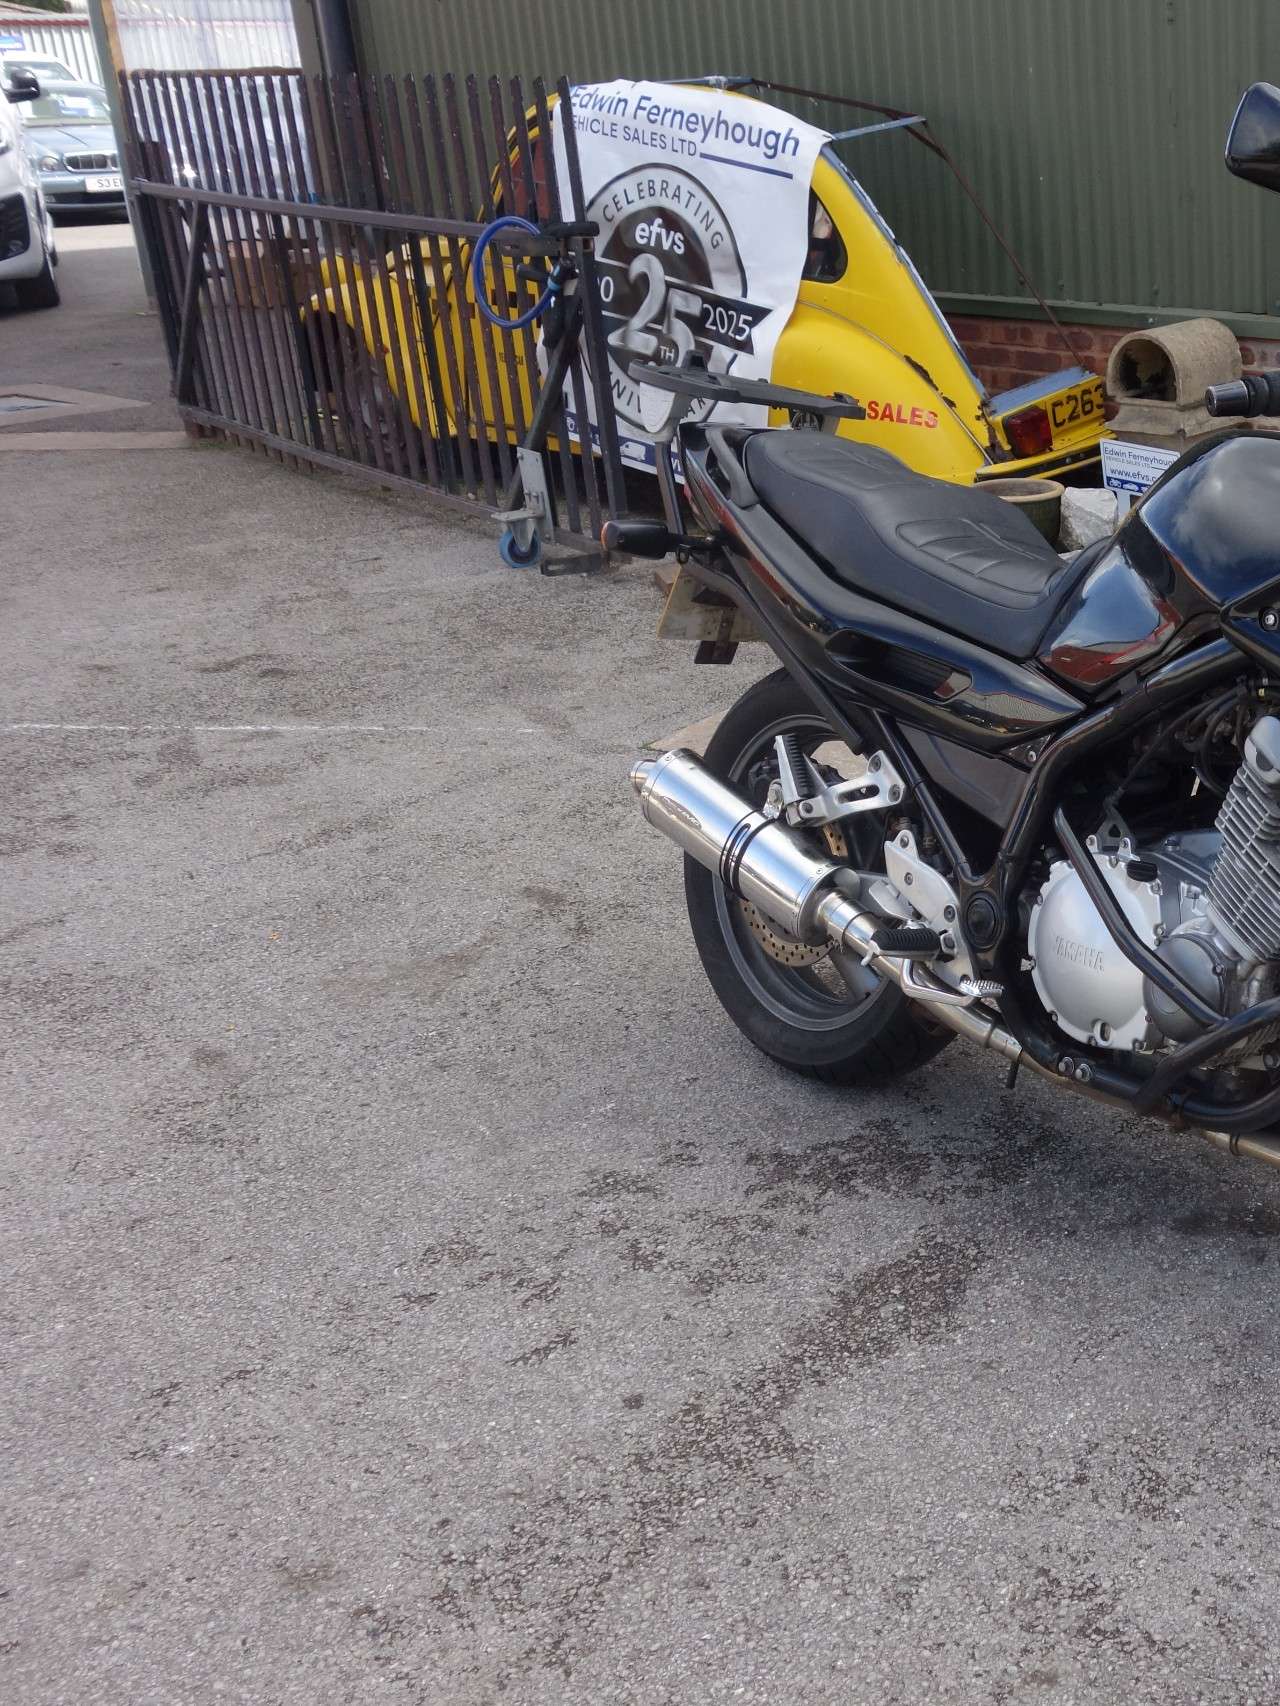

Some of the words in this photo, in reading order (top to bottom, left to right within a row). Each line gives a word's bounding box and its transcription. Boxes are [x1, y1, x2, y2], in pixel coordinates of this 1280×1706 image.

[571, 85, 629, 118] Edwin
[634, 94, 800, 160] Ferneyhough
[571, 114, 618, 138] EHICLE
[622, 125, 667, 150] SALES
[671, 138, 697, 157] LTD
[602, 179, 724, 250] CELEBRATING
[634, 217, 685, 255] efvs
[702, 303, 753, 342] 2025
[866, 399, 939, 429] SALES
[1104, 447, 1127, 459] Edwin
[1110, 468, 1157, 482] www.efvs.c
